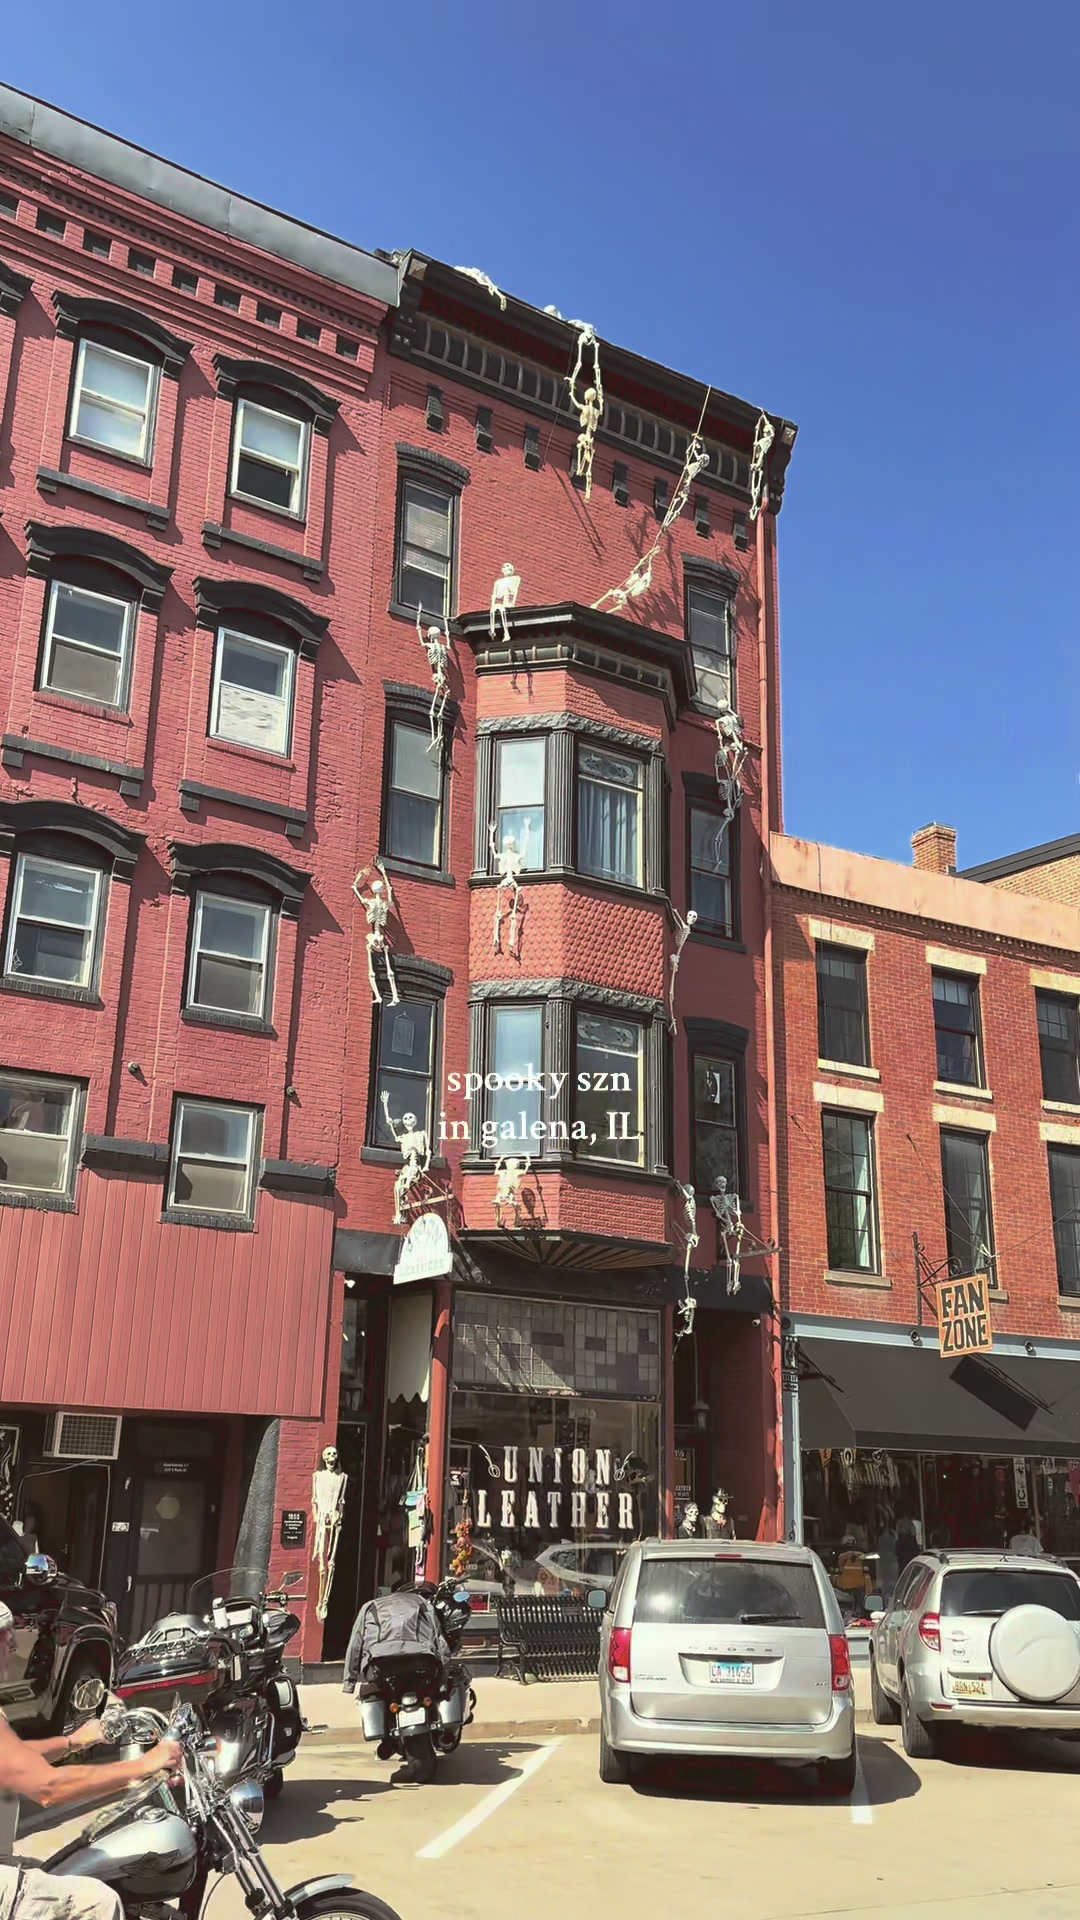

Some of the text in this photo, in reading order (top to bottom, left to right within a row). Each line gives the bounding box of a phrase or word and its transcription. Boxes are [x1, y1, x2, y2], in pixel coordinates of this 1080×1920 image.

[941, 1280, 985, 1318] FAN
[941, 1314, 989, 1352] ZONE
[503, 1445, 612, 1485] UNION
[476, 1489, 634, 1530] LEATHER
